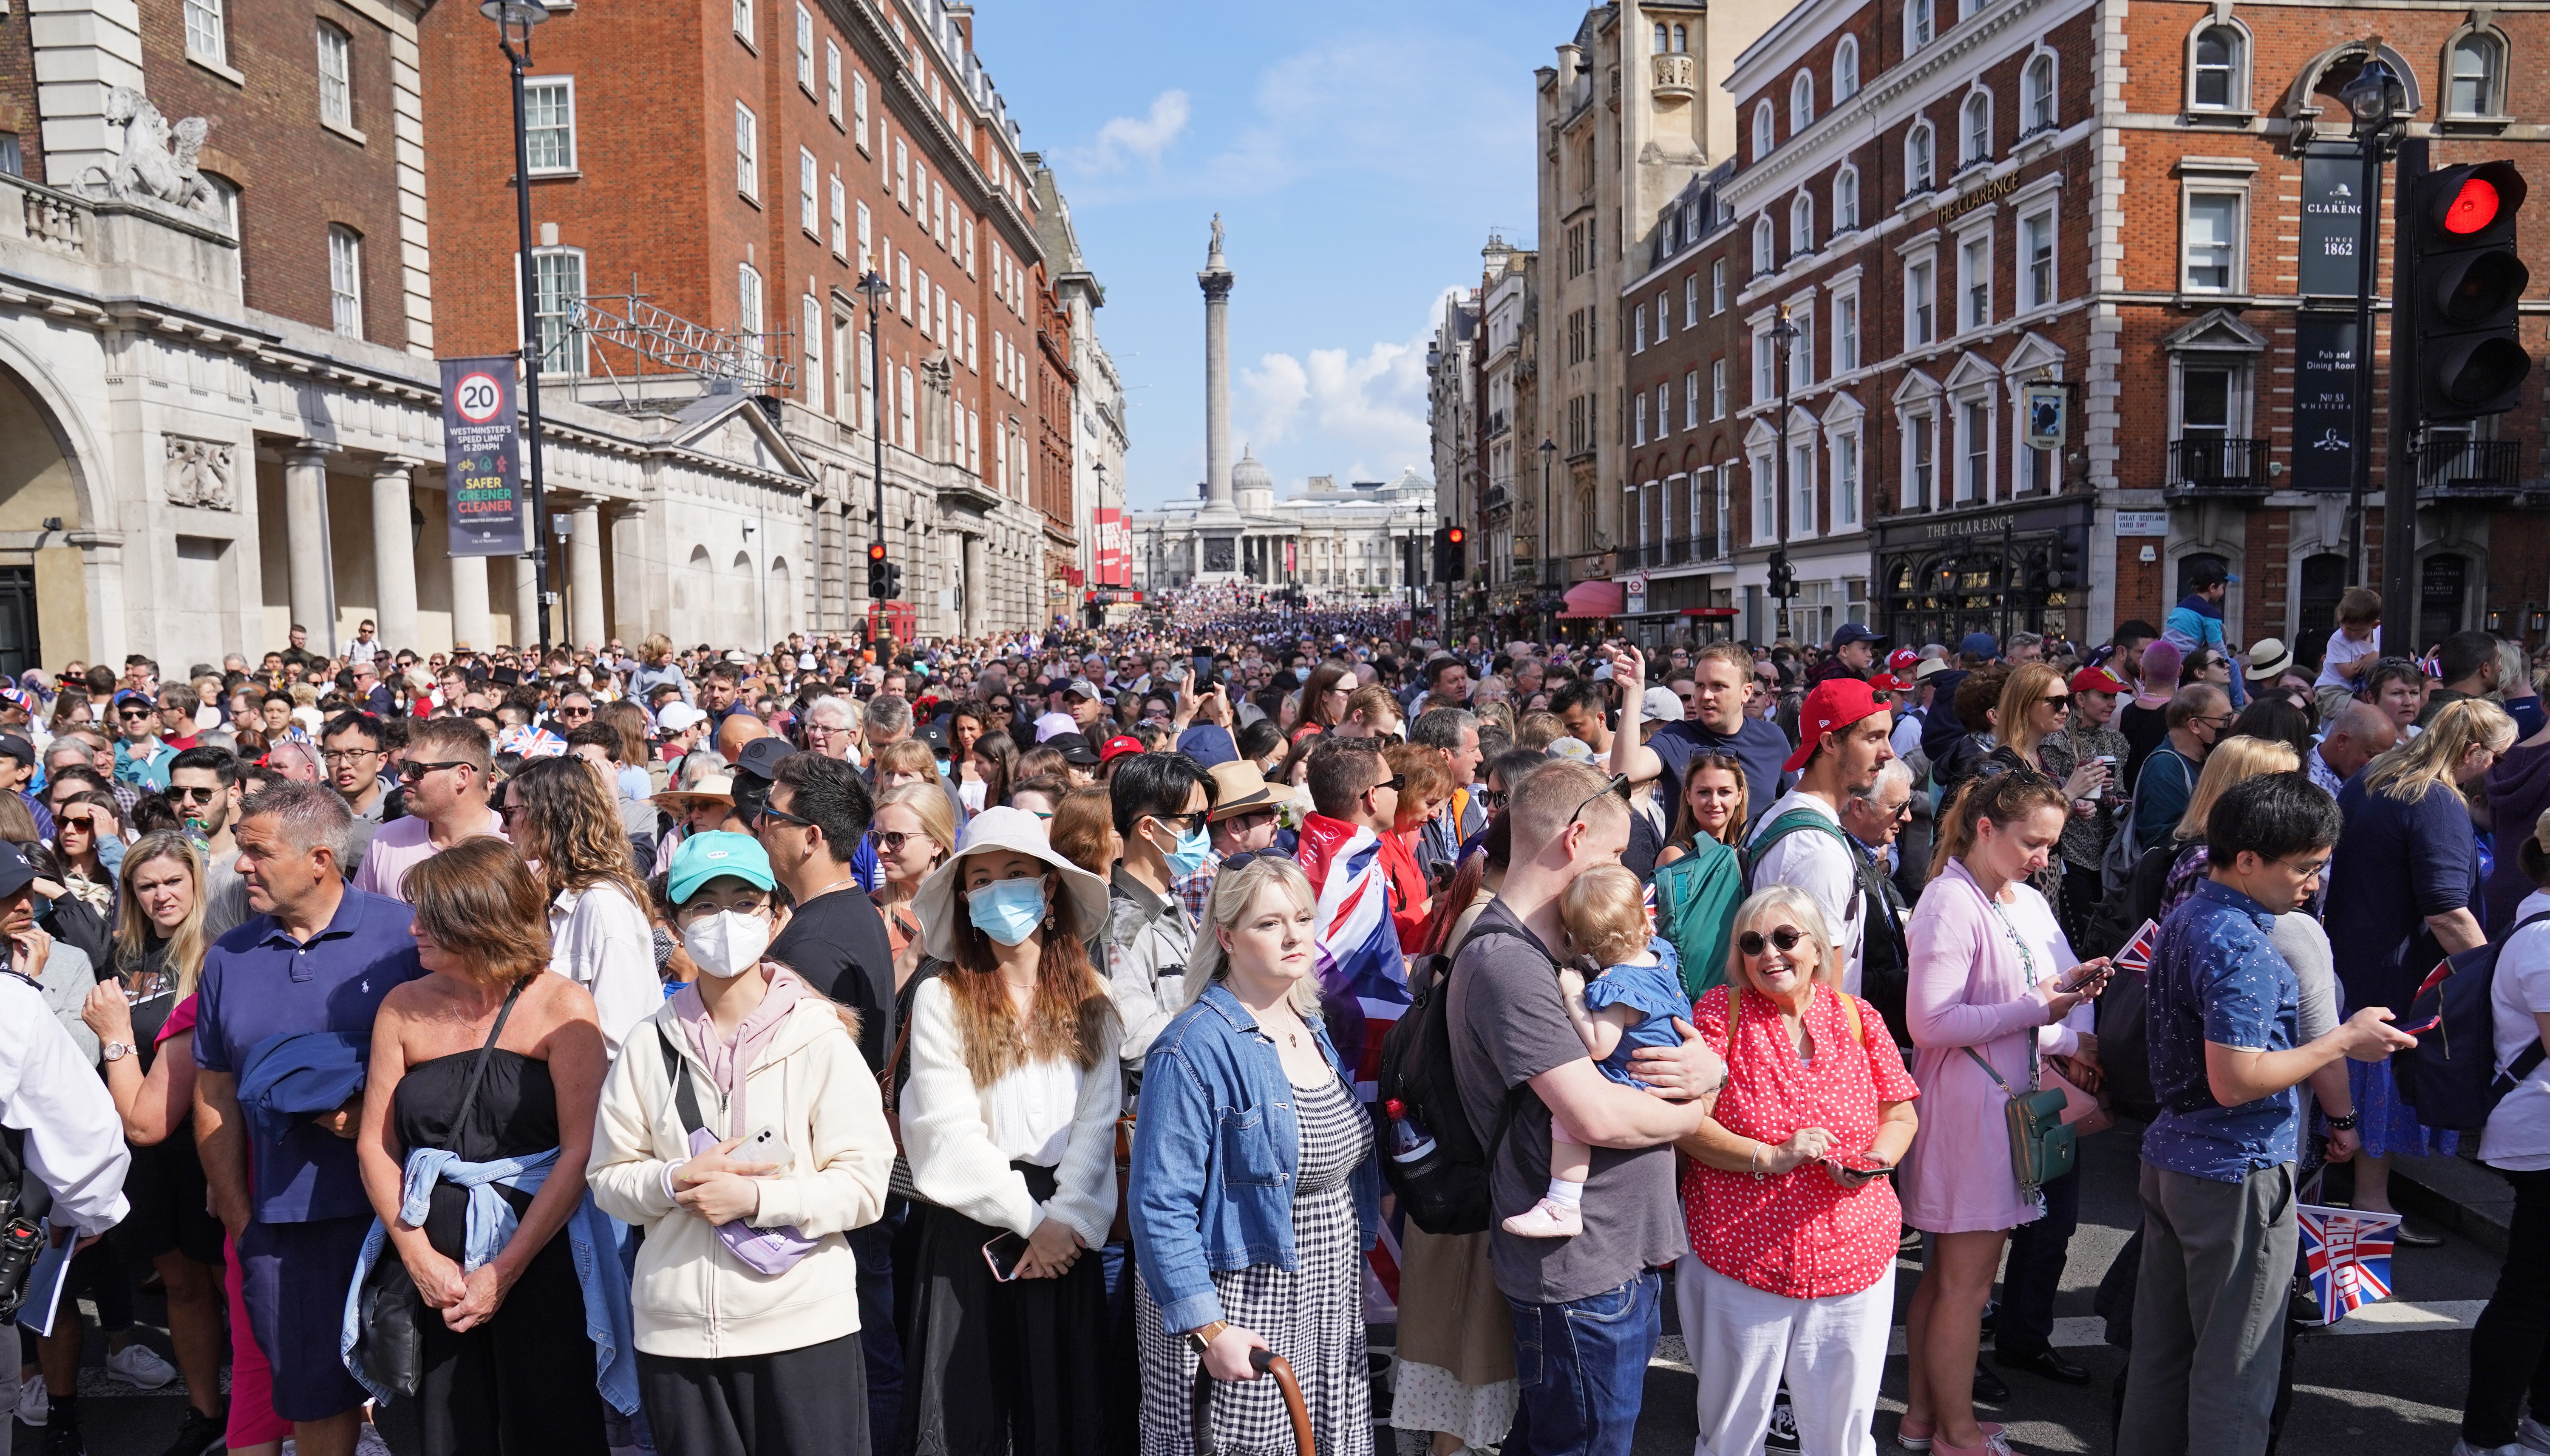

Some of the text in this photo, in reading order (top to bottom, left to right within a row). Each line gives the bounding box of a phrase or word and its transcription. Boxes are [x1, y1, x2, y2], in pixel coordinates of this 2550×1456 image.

[1936, 170, 2019, 225] THE CLARENCE
[2307, 204, 2361, 214] CLARENC
[2324, 242, 2353, 256] 1862
[2319, 350, 2350, 359] Pub and
[2306, 361, 2332, 371] Dining
[464, 385, 494, 408] 20
[2335, 393, 2344, 402] 53
[450, 425, 512, 436] WESTMINSTER'S
[458, 434, 505, 444] SPEED LIMIT
[464, 442, 500, 452] IS 20MPH
[465, 476, 502, 489] SAFER
[457, 488, 512, 501] GREENER
[458, 500, 512, 513] CLEANER
[1927, 515, 2014, 538] THE CLARENCE
[2326, 1221, 2359, 1298] HELLO!
